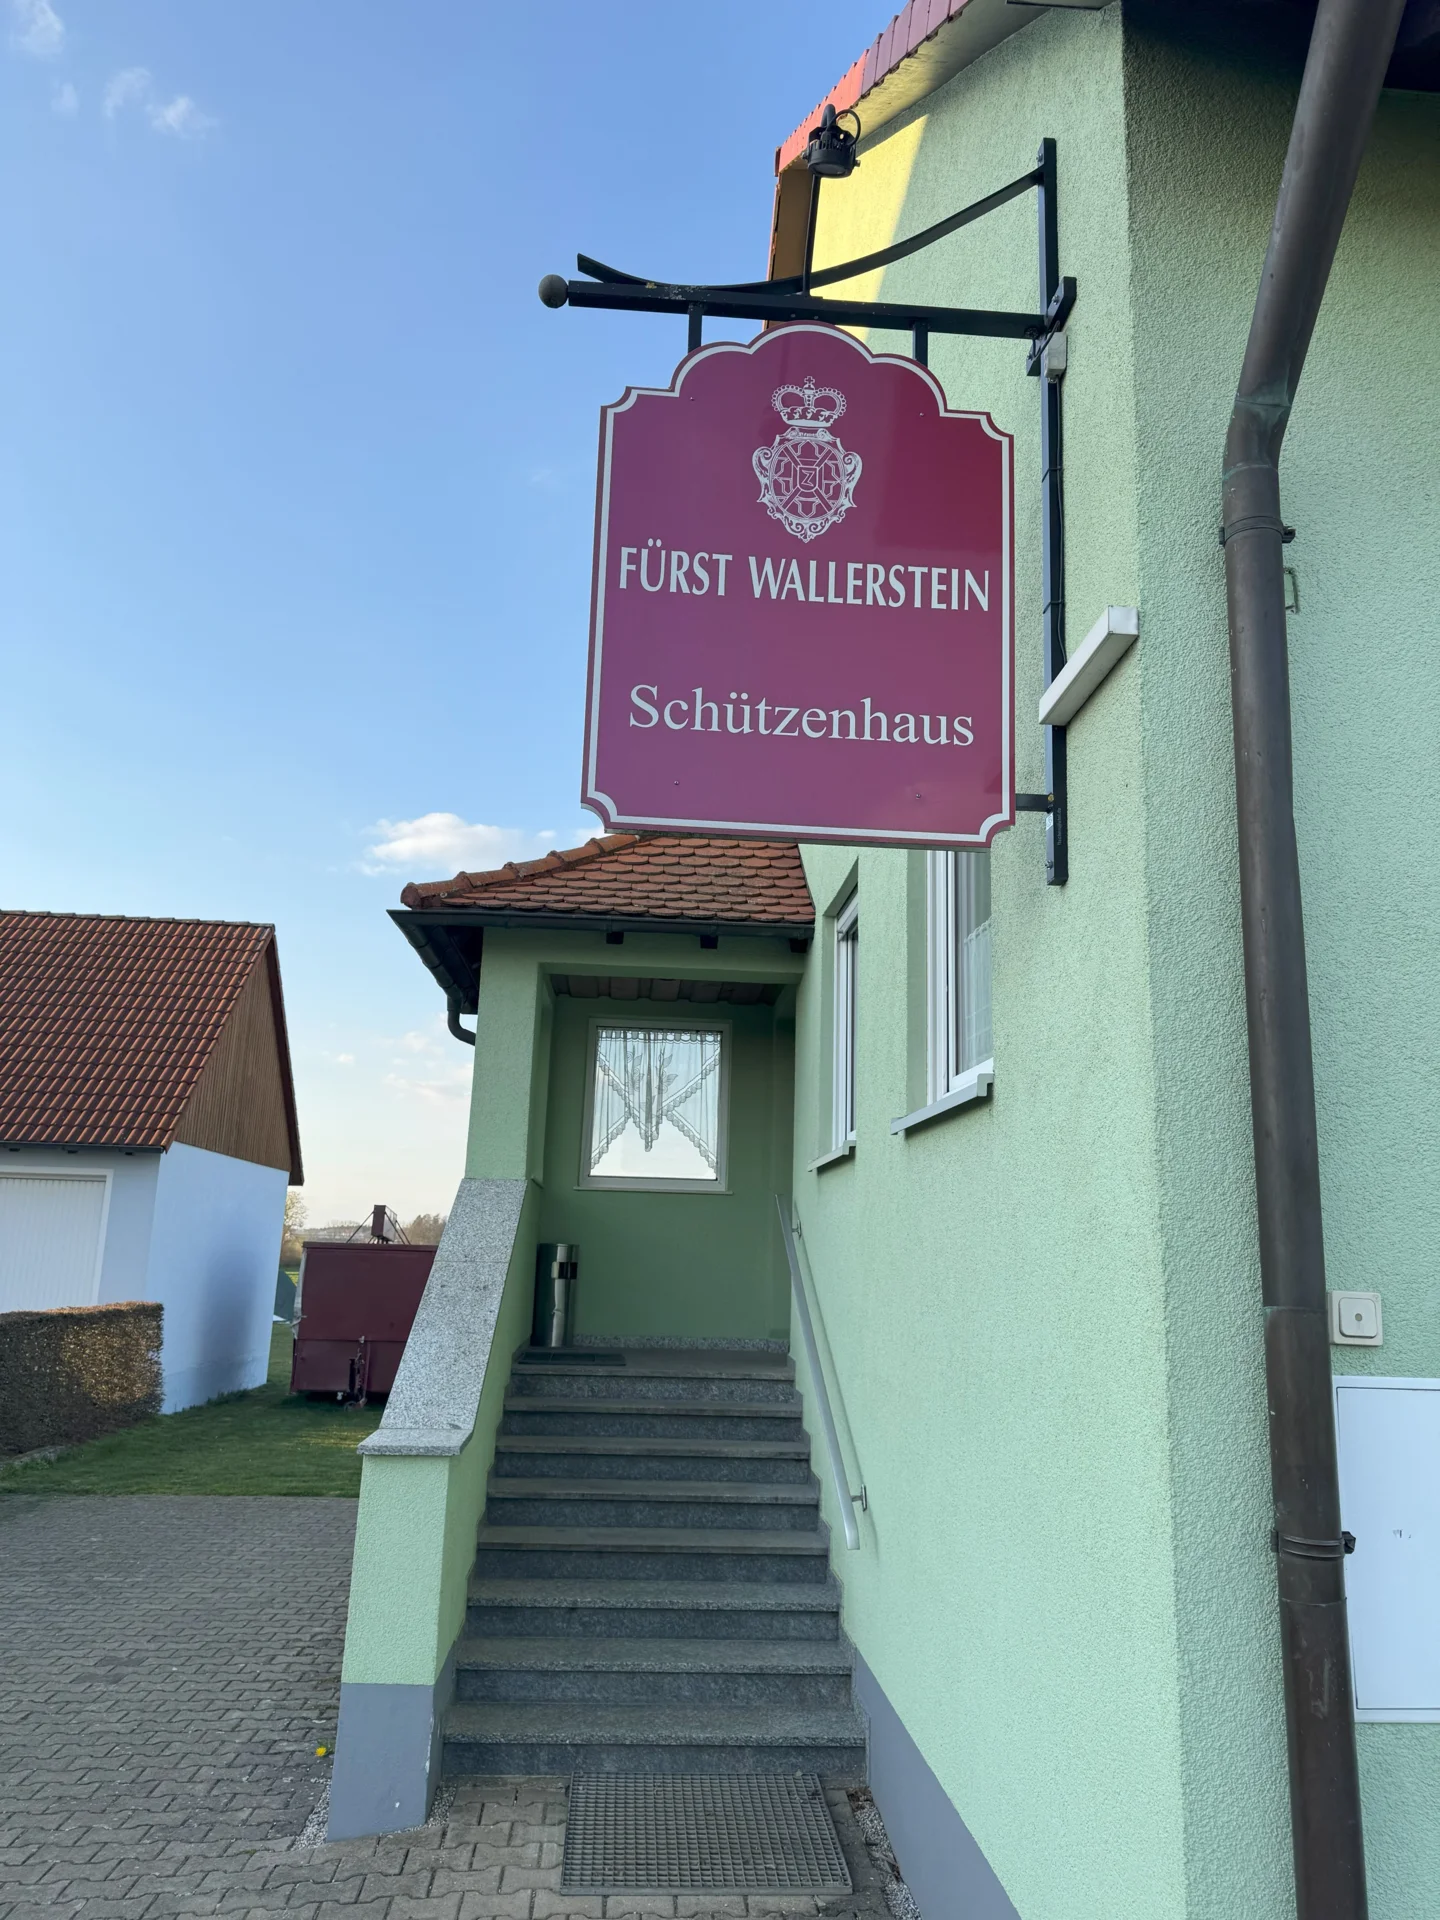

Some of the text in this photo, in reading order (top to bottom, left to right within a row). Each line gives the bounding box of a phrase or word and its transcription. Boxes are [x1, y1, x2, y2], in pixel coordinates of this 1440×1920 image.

[619, 538, 990, 612] FÜRST WALLERSTEIN
[629, 684, 974, 747] Schützenhaus
